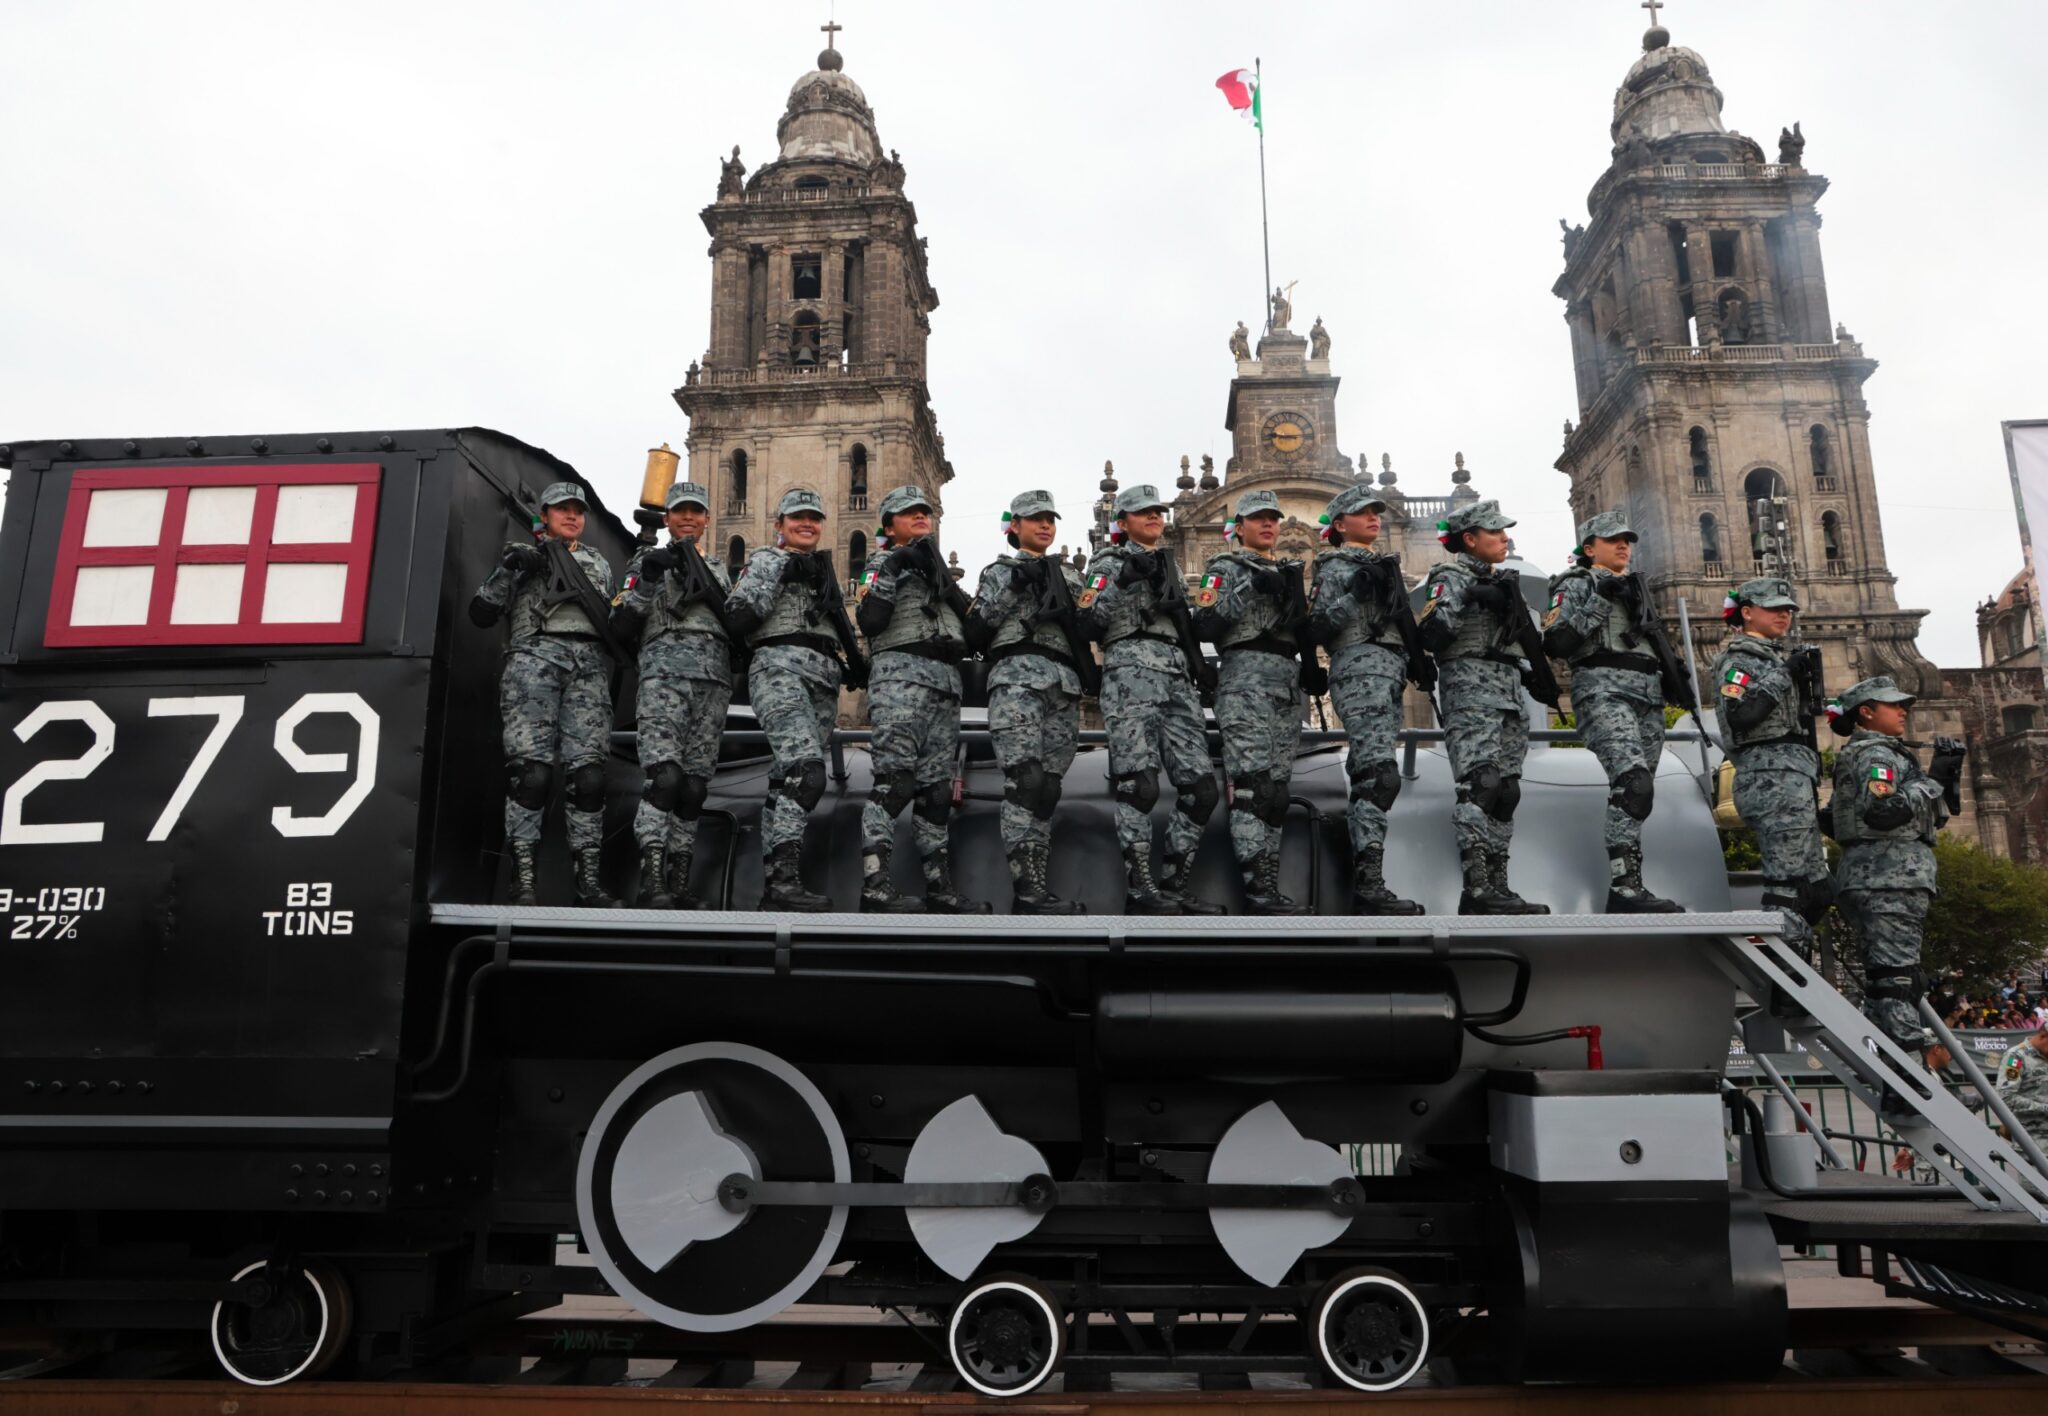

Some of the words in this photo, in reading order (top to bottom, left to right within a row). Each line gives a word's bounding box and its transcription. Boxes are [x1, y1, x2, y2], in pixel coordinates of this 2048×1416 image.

[0, 693, 381, 845] 279
[286, 882, 333, 907] 83
[10, 915, 81, 940] 27%
[262, 911, 354, 936] TONS
[1974, 1041, 2008, 1050] México
